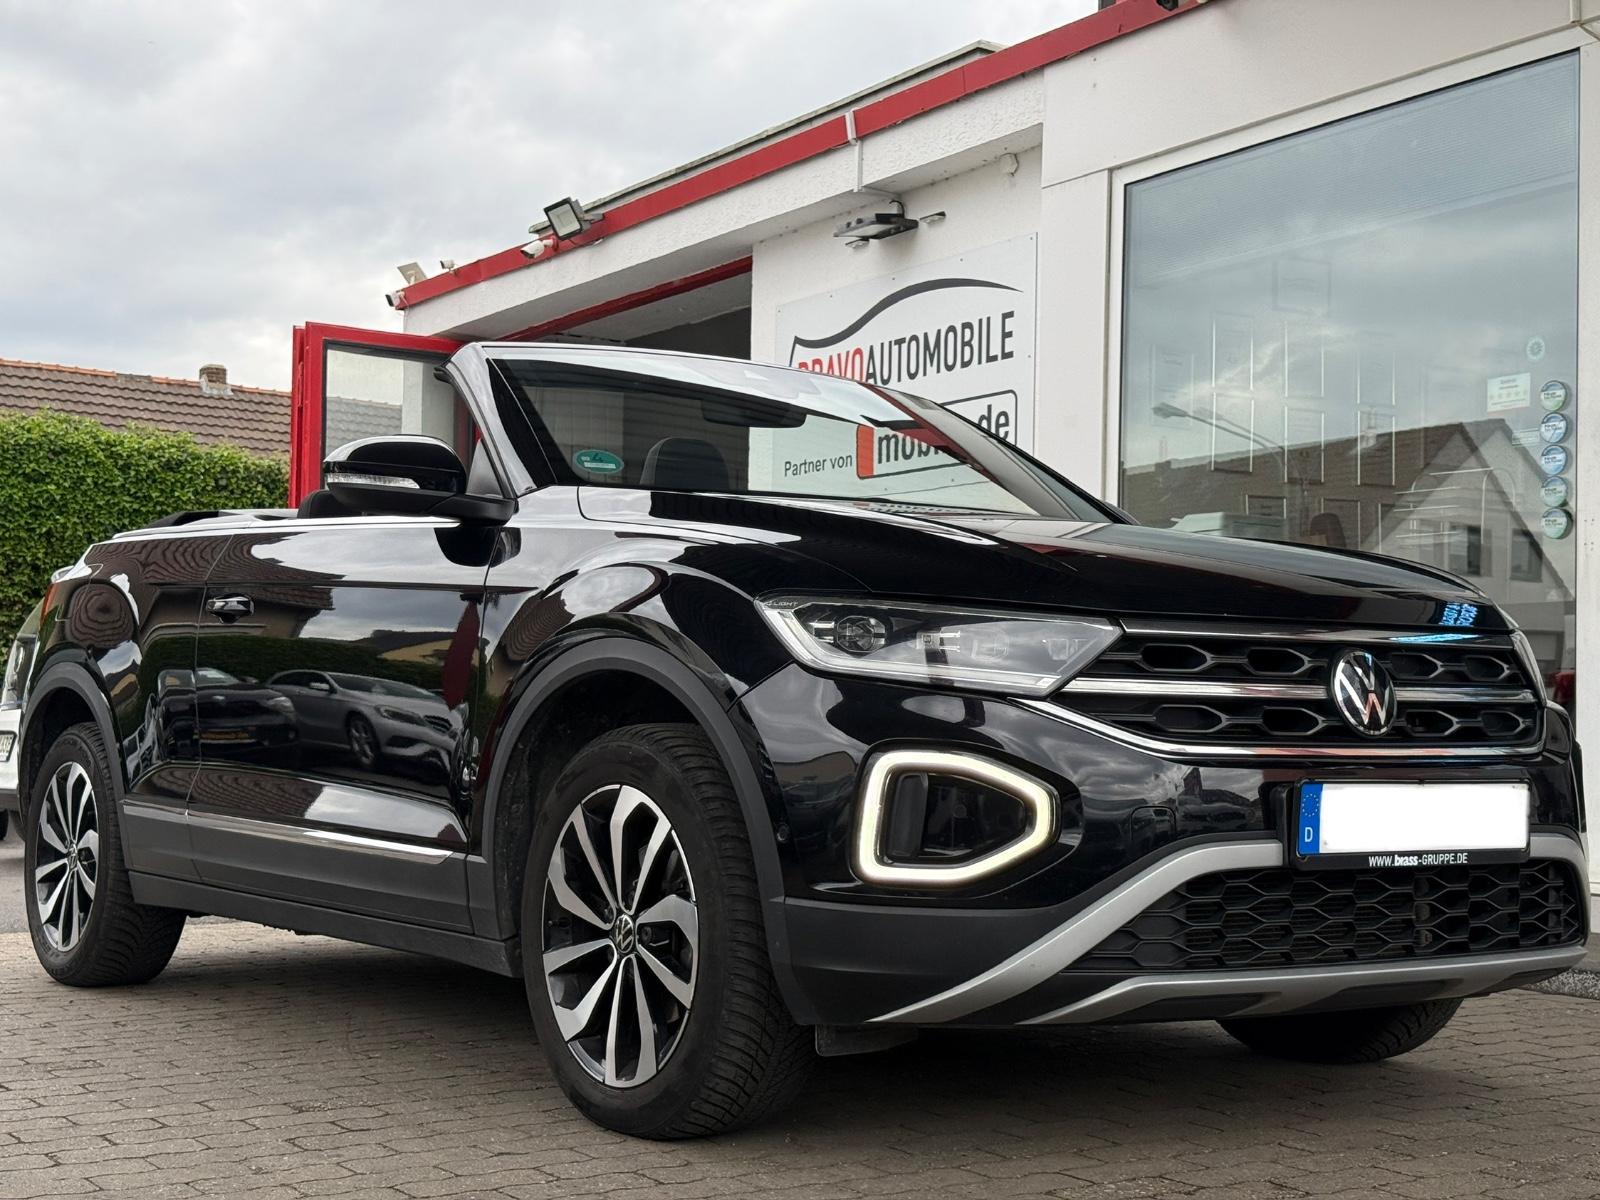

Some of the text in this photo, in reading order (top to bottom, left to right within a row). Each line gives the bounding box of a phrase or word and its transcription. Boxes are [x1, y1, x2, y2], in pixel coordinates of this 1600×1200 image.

[784, 454, 853, 477] Partner von
[1304, 826, 1313, 843] D
